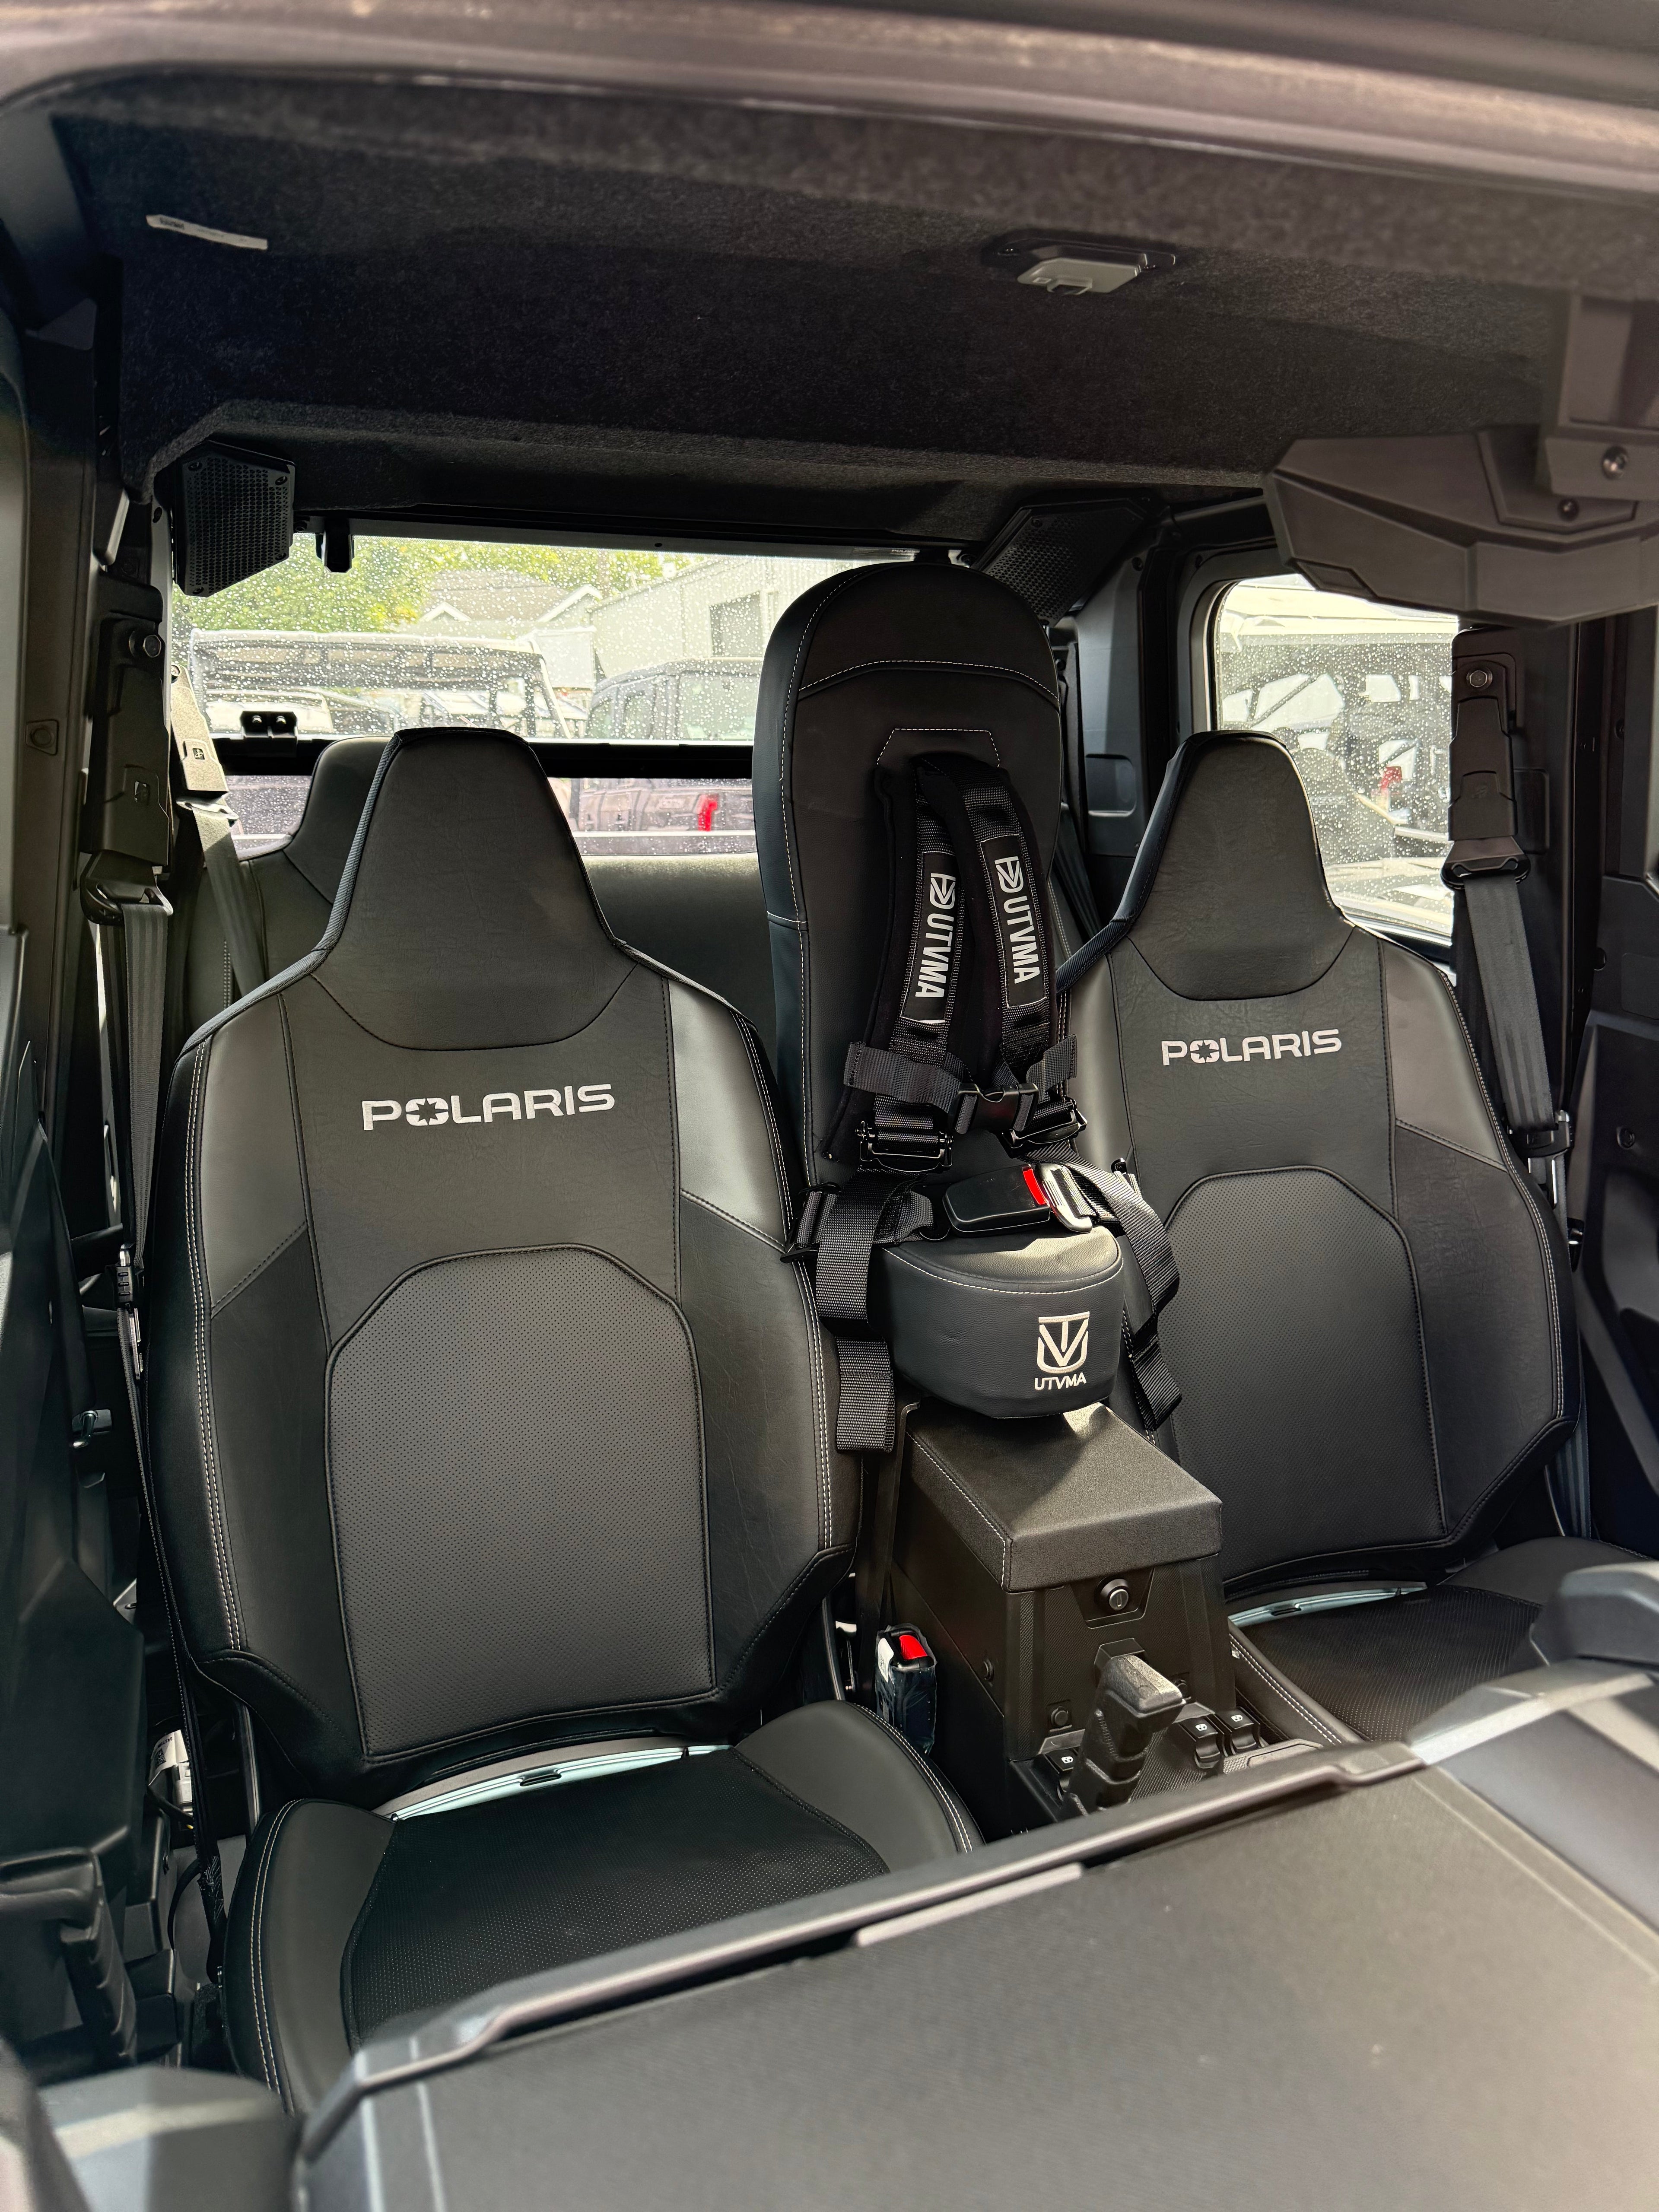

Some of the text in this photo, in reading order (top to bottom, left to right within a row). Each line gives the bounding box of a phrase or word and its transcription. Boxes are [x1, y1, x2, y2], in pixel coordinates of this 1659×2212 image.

[915, 913, 954, 998] UTVMA
[1003, 895, 1040, 984] UTVMA
[1161, 1029, 1342, 1066] POLARIS
[362, 1083, 615, 1131] POLARIS
[1034, 1372, 1087, 1390] UTVMA
